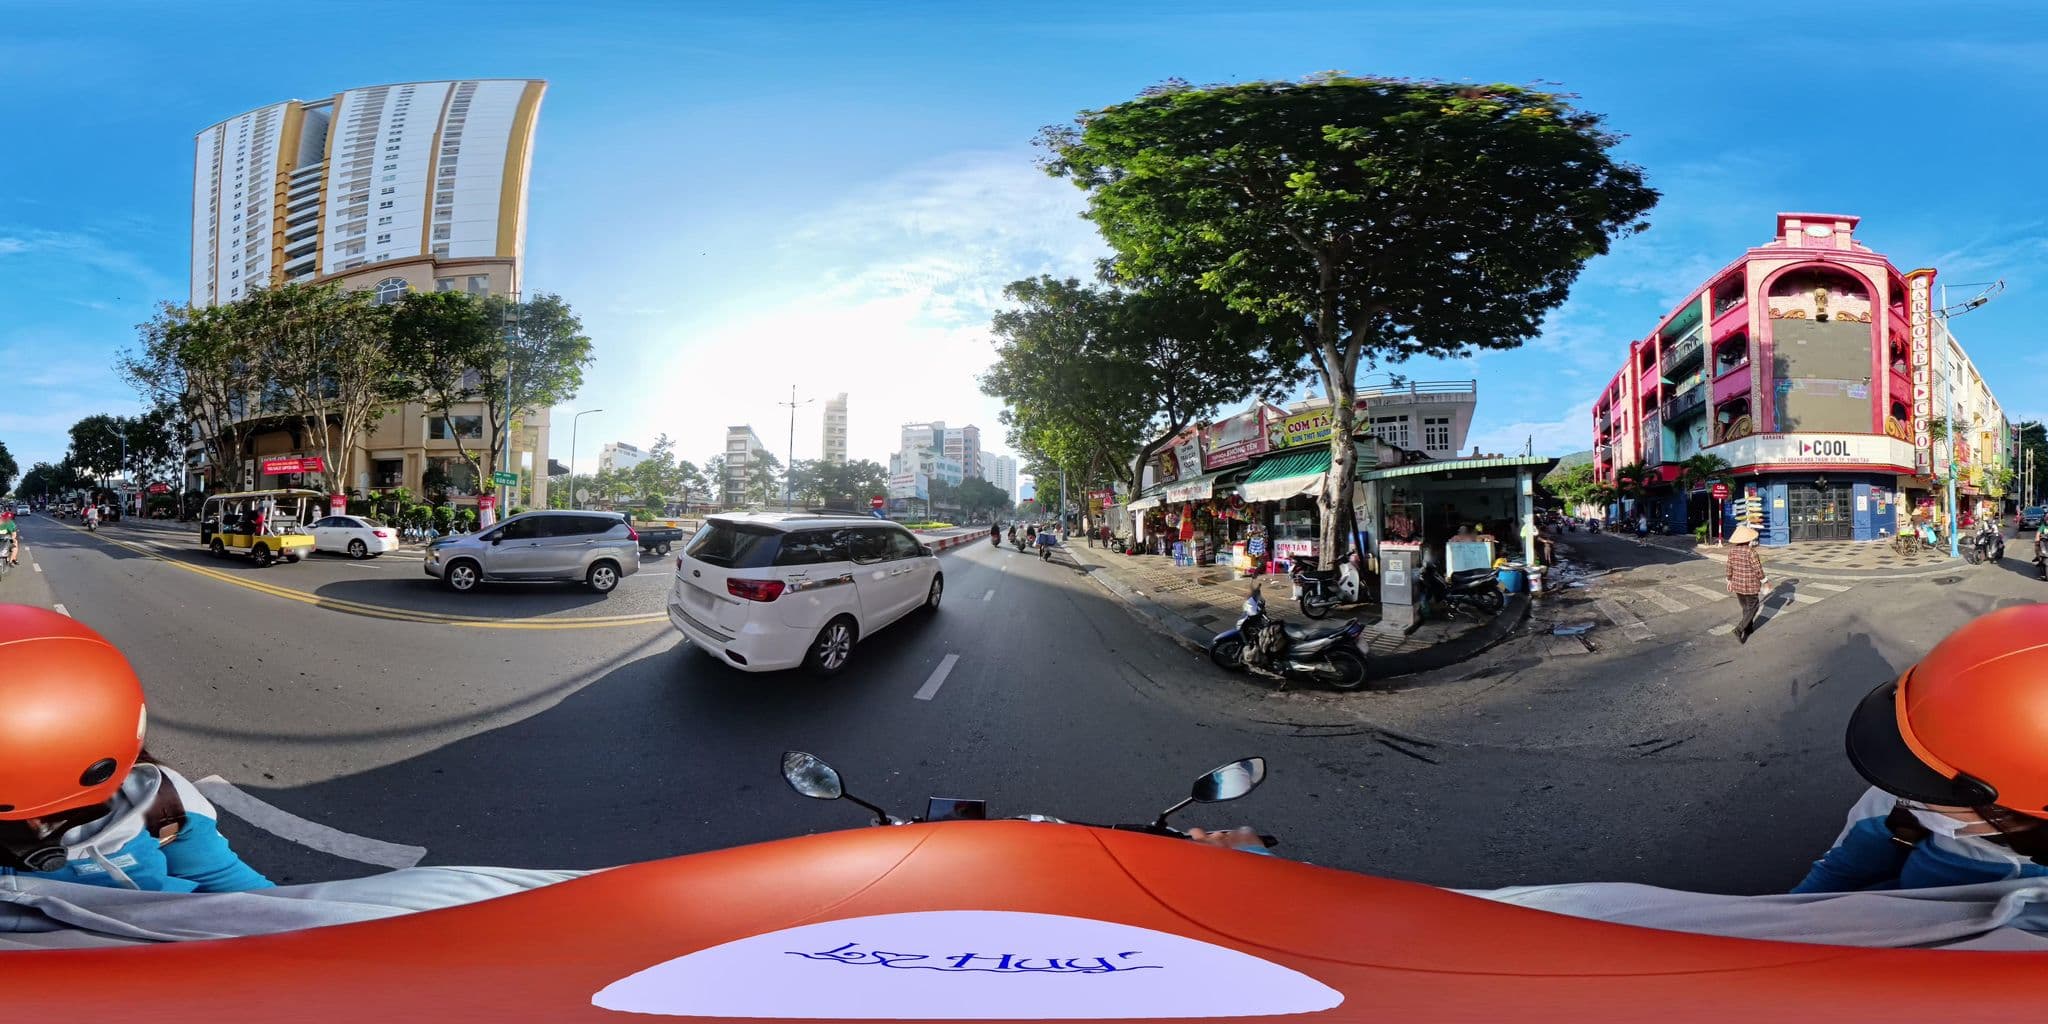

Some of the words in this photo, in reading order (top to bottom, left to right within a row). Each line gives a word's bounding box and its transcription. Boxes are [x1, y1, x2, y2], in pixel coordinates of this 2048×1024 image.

[1914, 279, 1927, 364] KARAOKE
[1312, 410, 1331, 428] TẤ
[1813, 440, 1850, 456] COOL
